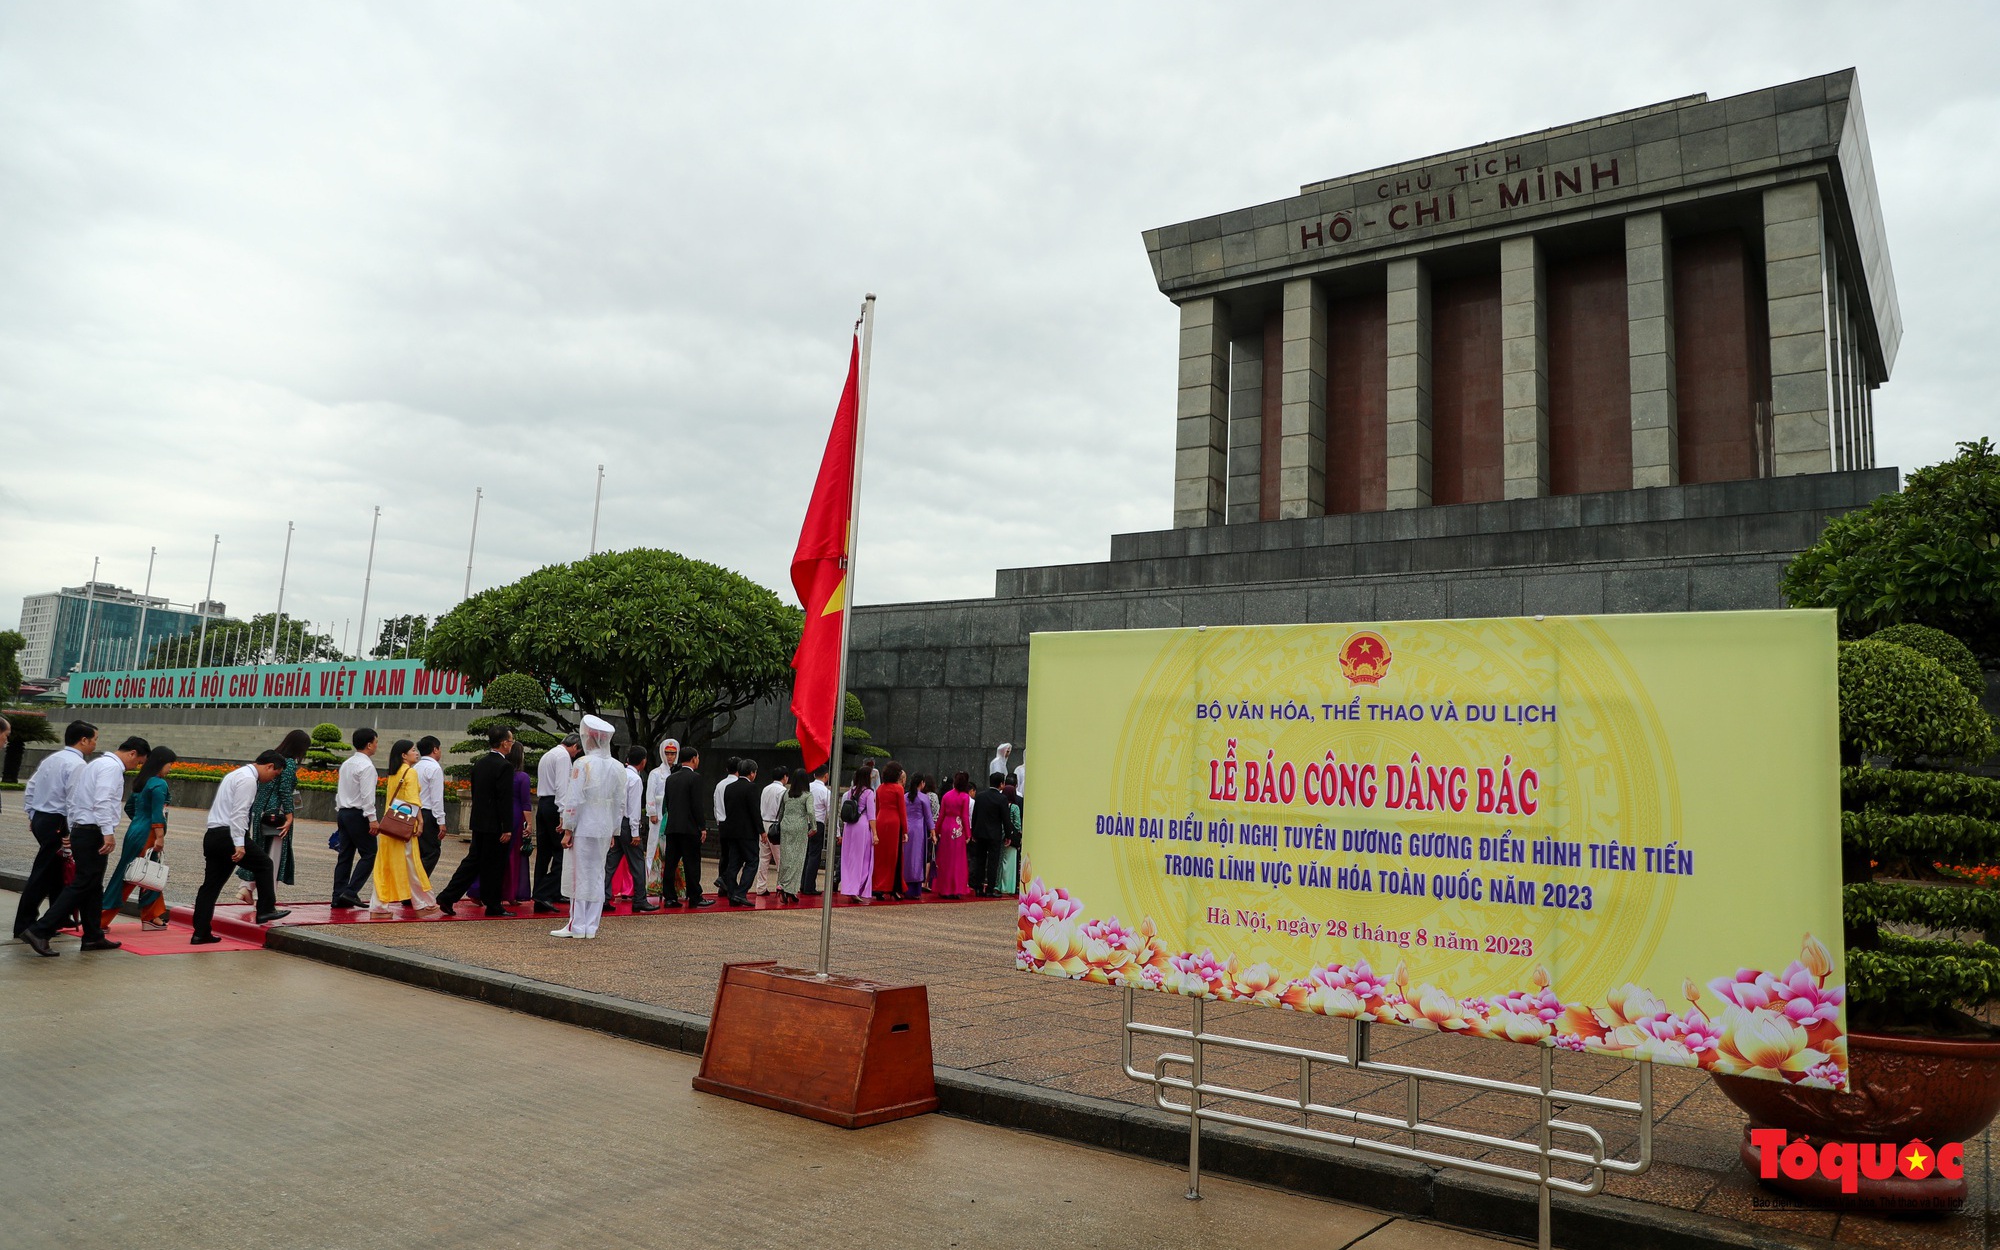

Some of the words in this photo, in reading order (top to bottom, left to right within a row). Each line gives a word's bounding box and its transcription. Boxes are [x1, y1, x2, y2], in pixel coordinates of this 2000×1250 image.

[82, 674, 111, 698] NƯỚC
[114, 674, 146, 702] CỘNG
[149, 672, 174, 698] HÒA
[178, 671, 197, 698] XÃ
[200, 670, 225, 701] HỘI
[229, 667, 259, 697] CHỦ
[263, 667, 311, 697] NGHĨA
[319, 666, 357, 700] VIỆT
[363, 669, 406, 696] NAM
[1196, 701, 1222, 722] BỘ
[1227, 700, 1264, 720] VĂN
[1271, 700, 1315, 723] HÓA,
[1322, 696, 1361, 720] THỂ
[1367, 704, 1424, 721] THAO
[1430, 700, 1459, 721] VÀ
[1466, 704, 1496, 722] DU
[1504, 704, 1556, 726] LỊCH
[1209, 738, 1238, 801] LỄ
[1244, 749, 1297, 804] BÁO
[1304, 750, 1378, 808] CÔNG
[1385, 752, 1468, 812] DÂNG
[1476, 754, 1539, 816] BÁC
[1096, 812, 1135, 837] ĐOÀN
[1139, 817, 1163, 843] ĐẠI
[1169, 812, 1203, 841] BIỂU
[1208, 818, 1234, 848] HỘI
[1239, 823, 1278, 851] NGHỊ
[1284, 823, 1336, 850] TUYÊN
[1343, 829, 1403, 855] DƯƠNG
[1409, 832, 1472, 860] GƯƠNG
[1479, 829, 1525, 863] ĐIỂN
[1532, 836, 1581, 867] HÌNH
[1589, 840, 1636, 871] TIÊN
[1644, 841, 1693, 875] TIẾN
[1165, 854, 1214, 879] TRONG
[1219, 855, 1255, 882] LĨNH
[1261, 860, 1292, 889] VỰC
[1298, 861, 1331, 888] VĂN
[1338, 864, 1372, 892] HÓA
[1378, 867, 1426, 896] TOÀN
[1432, 869, 1482, 900] QUỐC
[1490, 875, 1535, 905] NĂM
[1542, 882, 1593, 911] 2023
[1207, 907, 1231, 926] Hà
[1236, 910, 1271, 933] Nội,
[1277, 917, 1321, 938] ngày
[1326, 919, 1348, 937] 28
[1353, 922, 1411, 948] tháng
[1416, 928, 1428, 946] 8
[1433, 931, 1479, 951] năm
[1485, 935, 1533, 957] 2023
